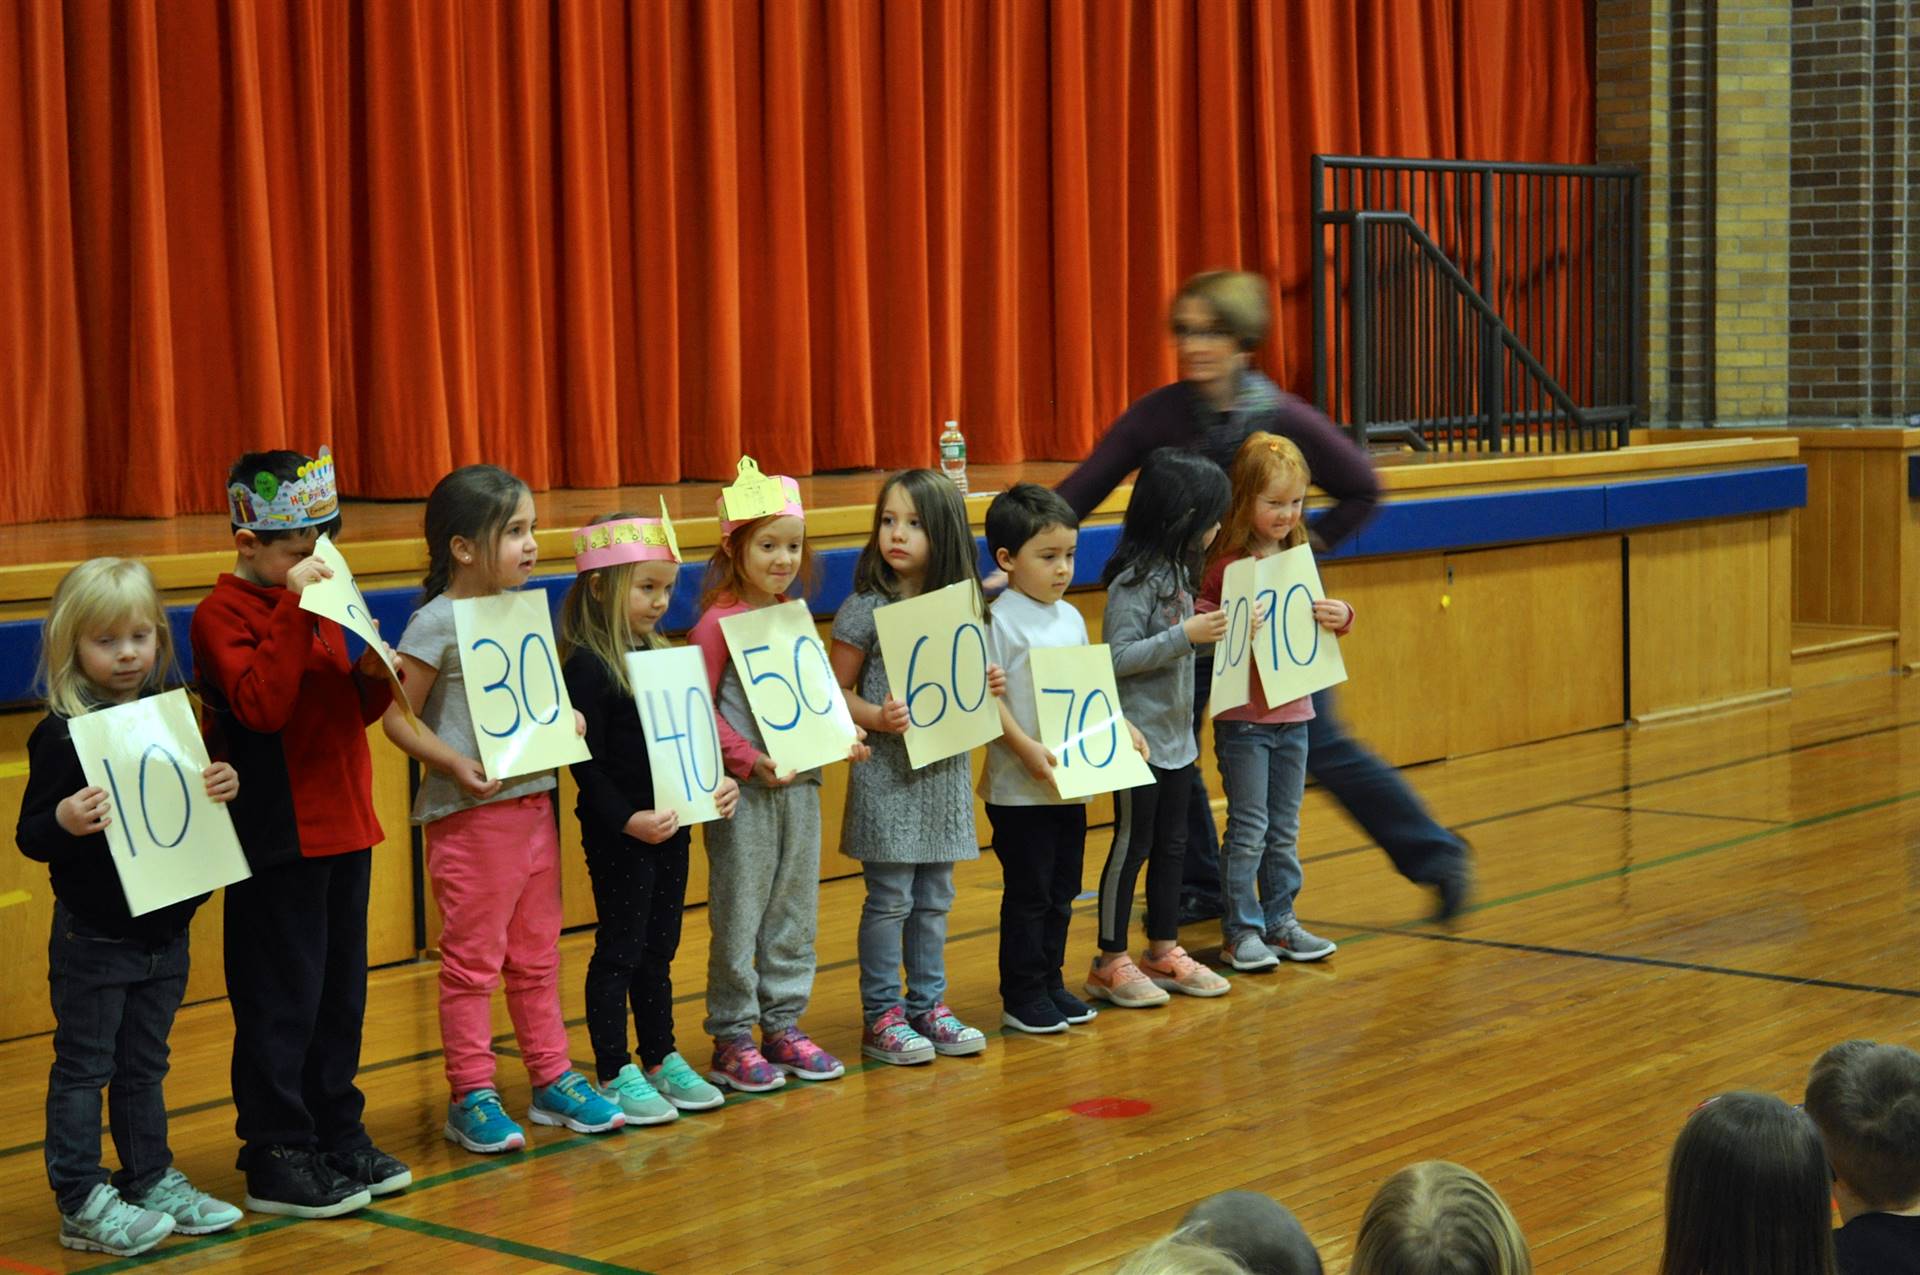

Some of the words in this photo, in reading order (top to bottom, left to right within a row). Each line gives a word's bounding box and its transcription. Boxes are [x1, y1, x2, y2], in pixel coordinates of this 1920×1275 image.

[905, 623, 987, 728] 60
[1255, 583, 1319, 671] 90
[472, 633, 560, 738] 30
[742, 635, 833, 731] 50
[1041, 689, 1117, 768] 70
[645, 687, 719, 801] 40
[101, 743, 191, 858] 10
